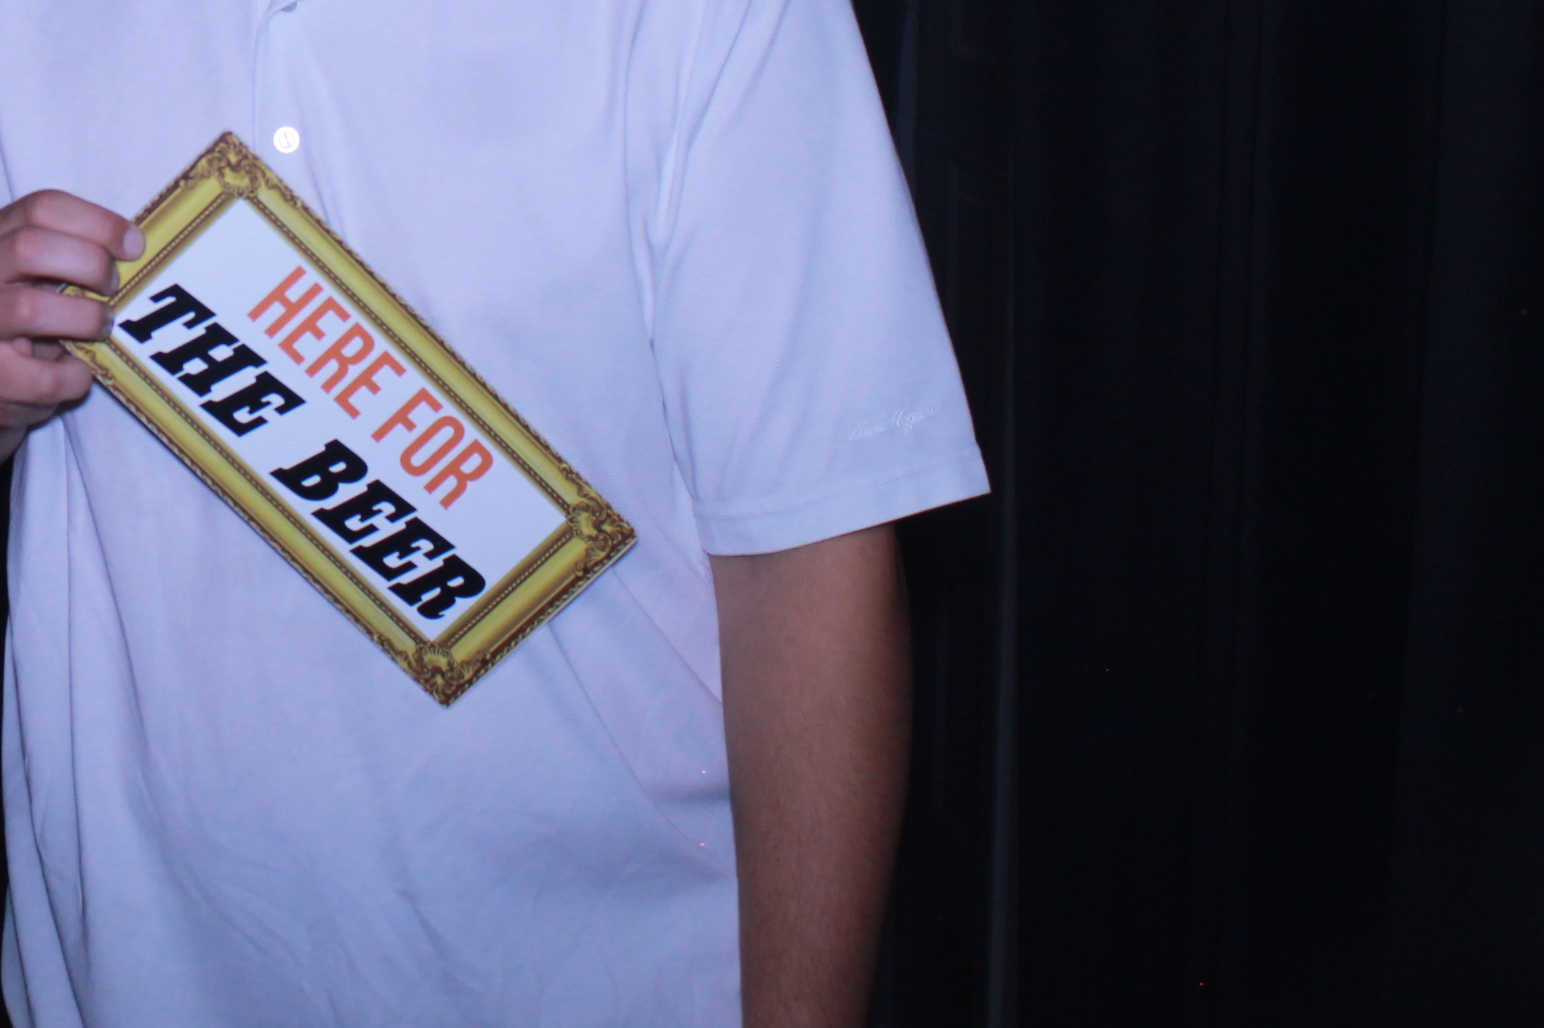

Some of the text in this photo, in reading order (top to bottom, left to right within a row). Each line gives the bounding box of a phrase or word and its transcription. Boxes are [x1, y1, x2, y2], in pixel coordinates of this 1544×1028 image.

[117, 283, 486, 620] THE BEER
[247, 266, 494, 510] HERE FOR
